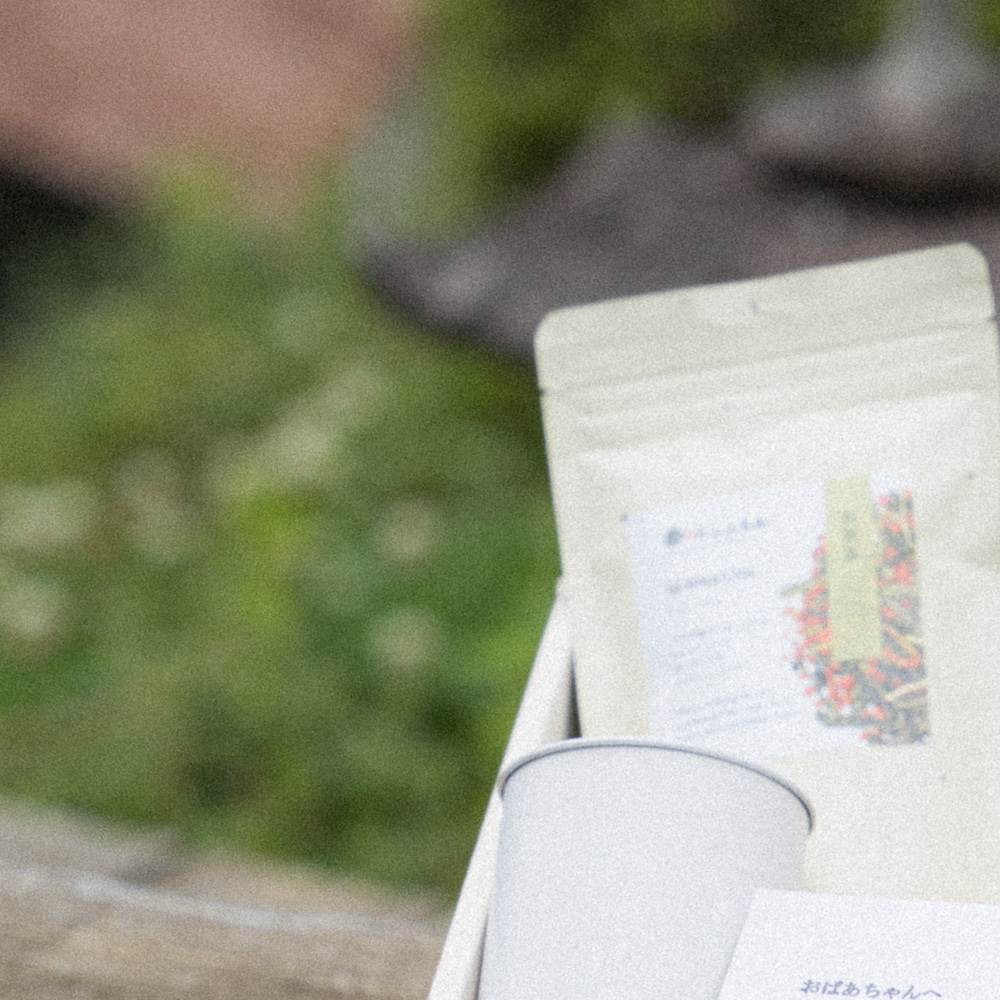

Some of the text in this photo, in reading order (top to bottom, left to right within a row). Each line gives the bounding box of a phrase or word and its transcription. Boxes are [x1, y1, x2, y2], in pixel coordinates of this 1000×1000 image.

[801, 979, 942, 999] おばあちゃんへ
